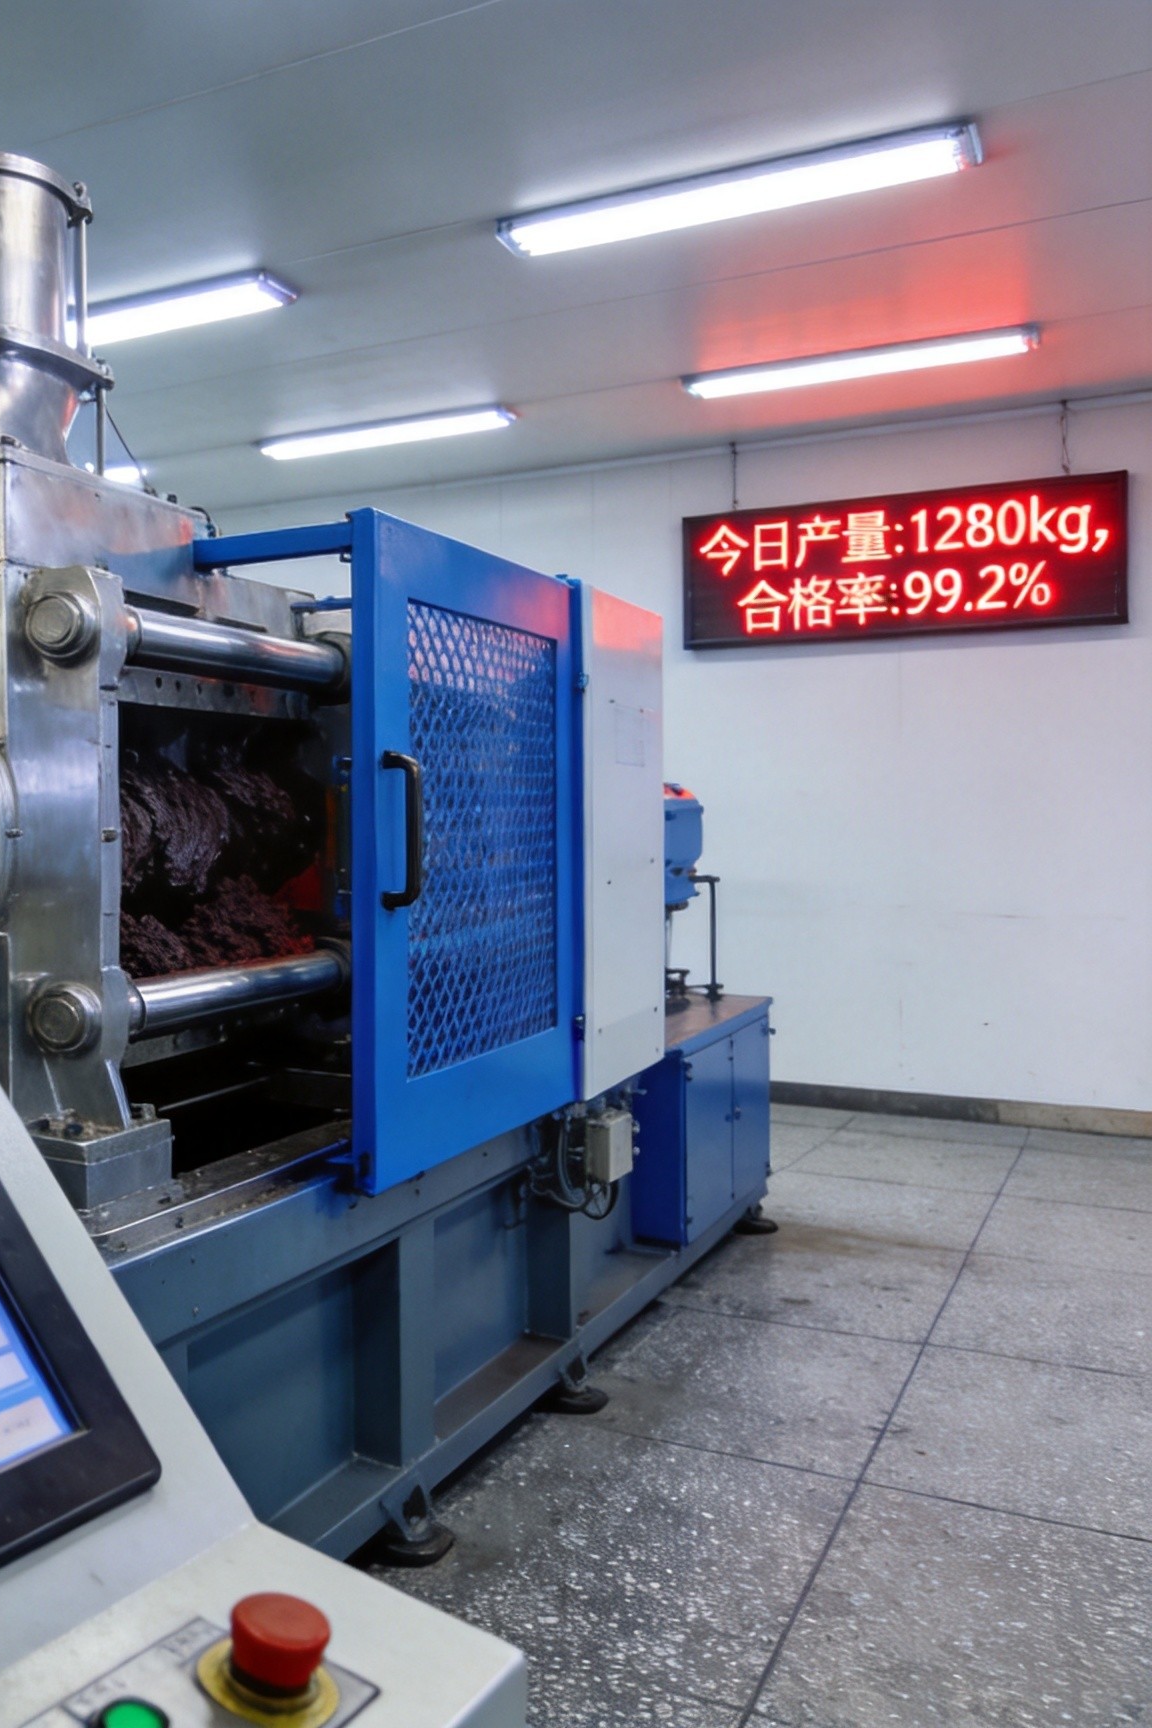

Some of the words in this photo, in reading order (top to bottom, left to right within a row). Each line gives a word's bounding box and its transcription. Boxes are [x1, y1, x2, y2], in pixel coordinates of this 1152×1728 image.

[698, 494, 1110, 577] 今日产量:1280kg,
[737, 560, 1051, 634] 合格率:99.2%
